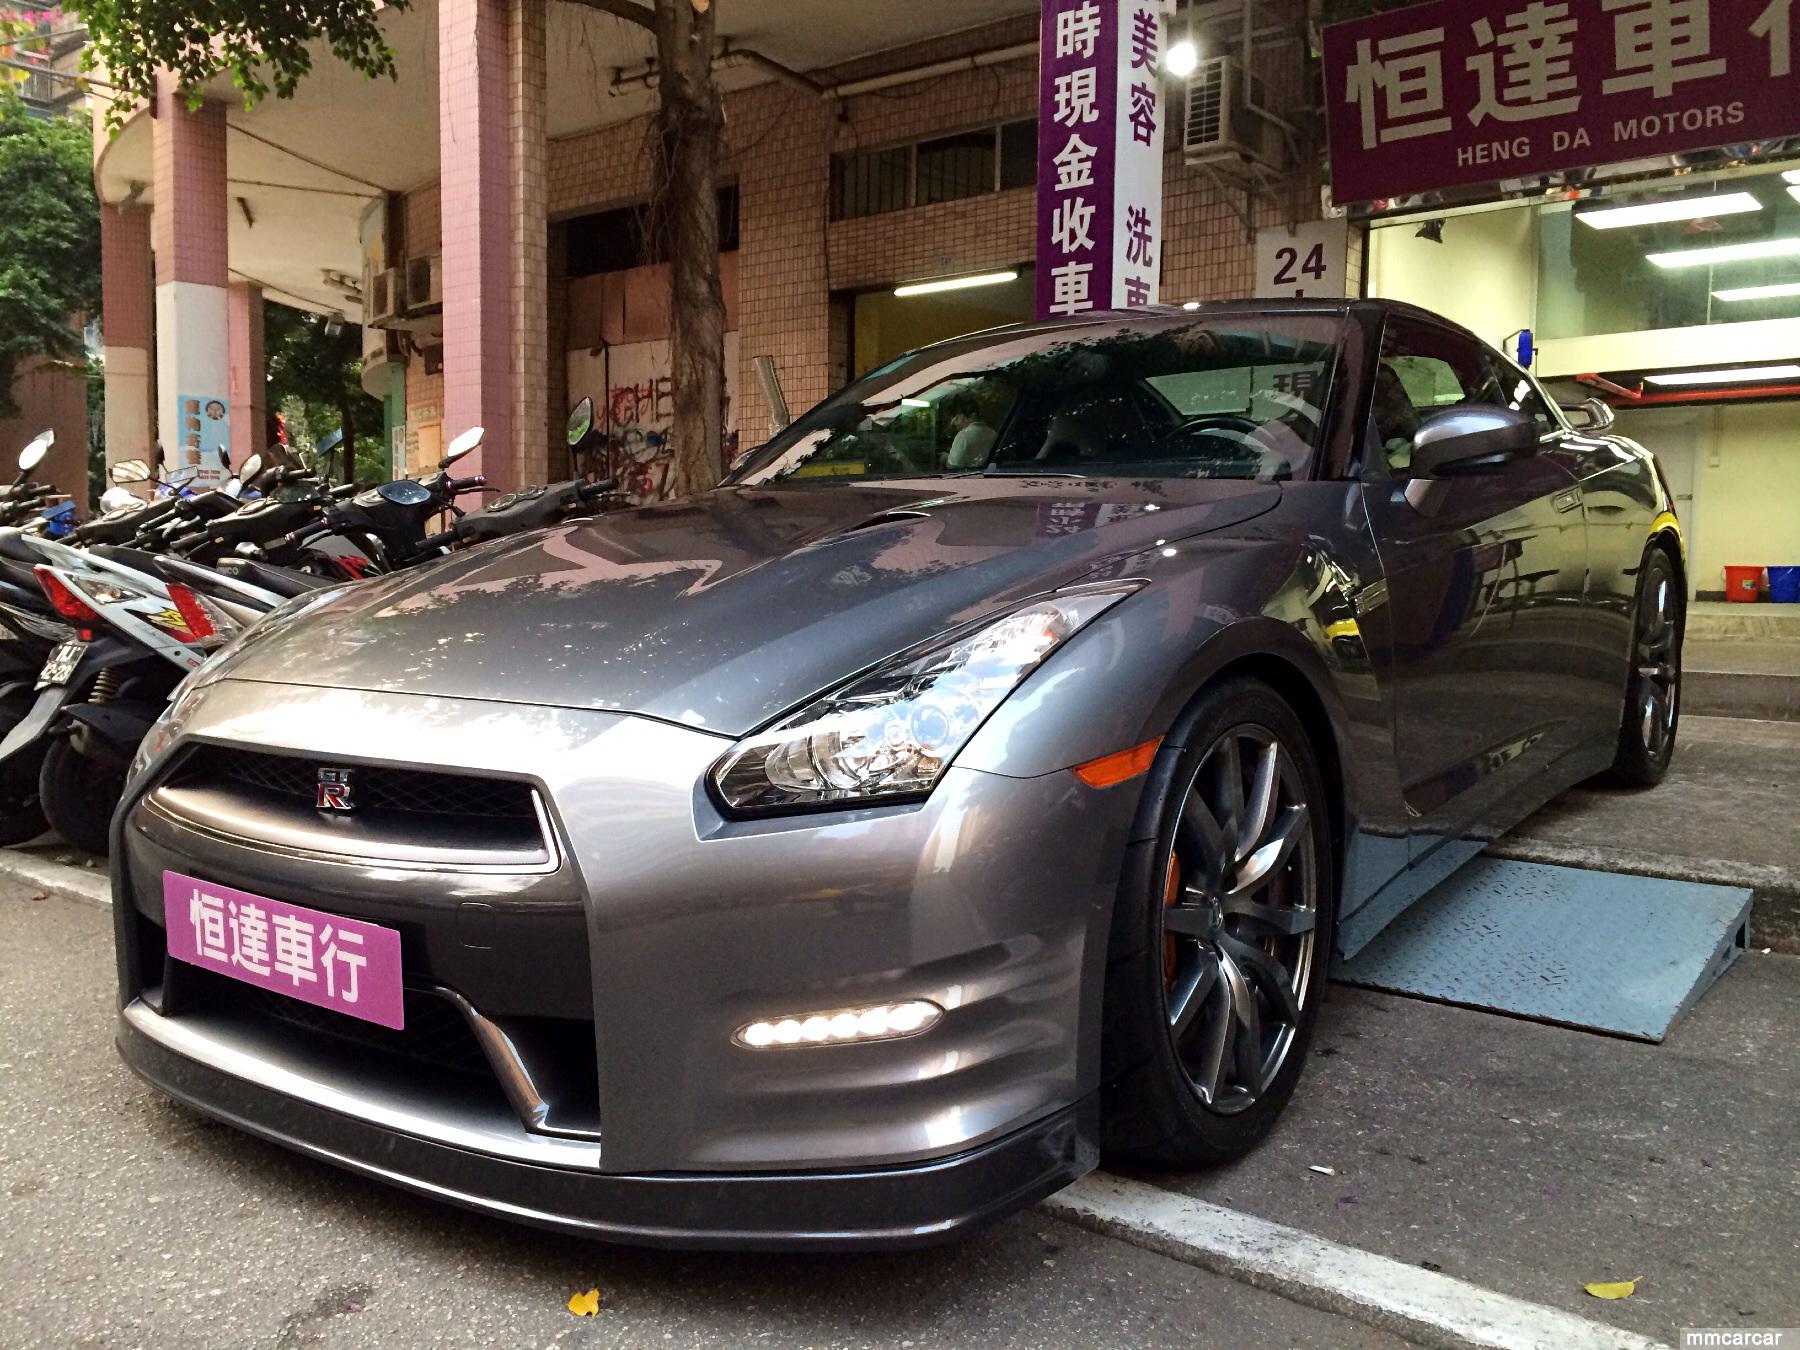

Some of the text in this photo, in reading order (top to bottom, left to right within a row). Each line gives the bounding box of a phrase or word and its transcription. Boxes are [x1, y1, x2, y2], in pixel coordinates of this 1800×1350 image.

[1129, 8, 1158, 147] 美容
[1457, 101, 1745, 167] HENG DA MOTORS
[1050, 1, 1101, 316] 時現金收車
[1273, 242, 1327, 285] 24
[189, 888, 367, 1003] 恒達車行
